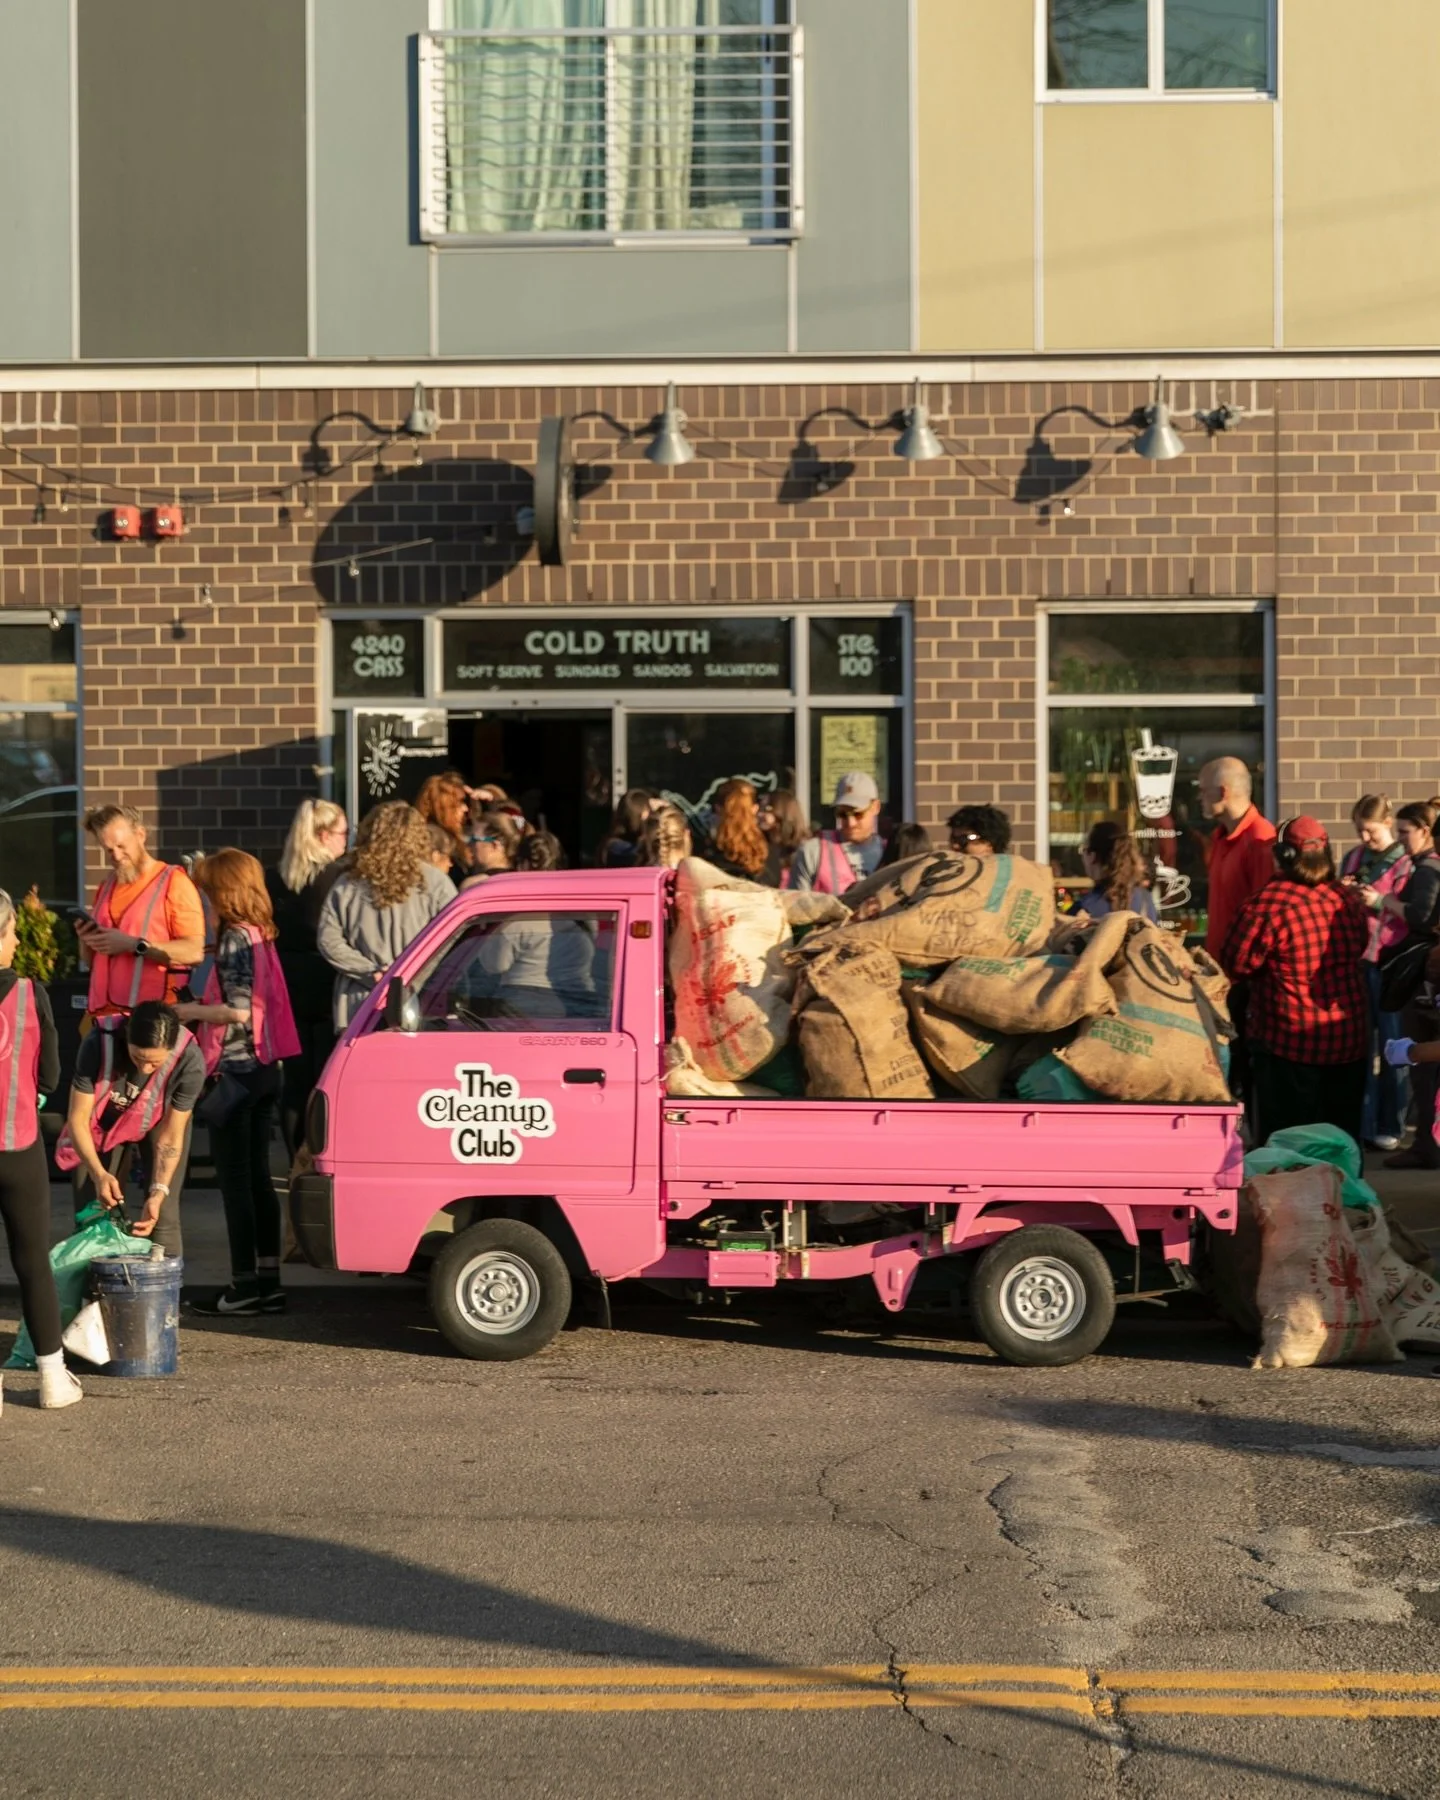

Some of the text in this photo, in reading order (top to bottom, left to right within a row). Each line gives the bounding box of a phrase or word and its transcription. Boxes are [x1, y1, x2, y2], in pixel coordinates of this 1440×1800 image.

[351, 634, 405, 655] 4240
[524, 629, 710, 655] COLD TRUTH
[353, 656, 404, 677] CASS
[456, 663, 779, 679] SOFT SERVE SUNDAES SANDOS SALVATION
[839, 657, 873, 677] 100
[519, 1036, 580, 1046] CARRY
[1089, 1028, 1153, 1057] NEUTRAL
[1091, 1018, 1153, 1046] CARBON
[462, 1069, 512, 1098] The
[425, 1095, 549, 1130] Cleanup
[458, 1128, 515, 1157] Club
